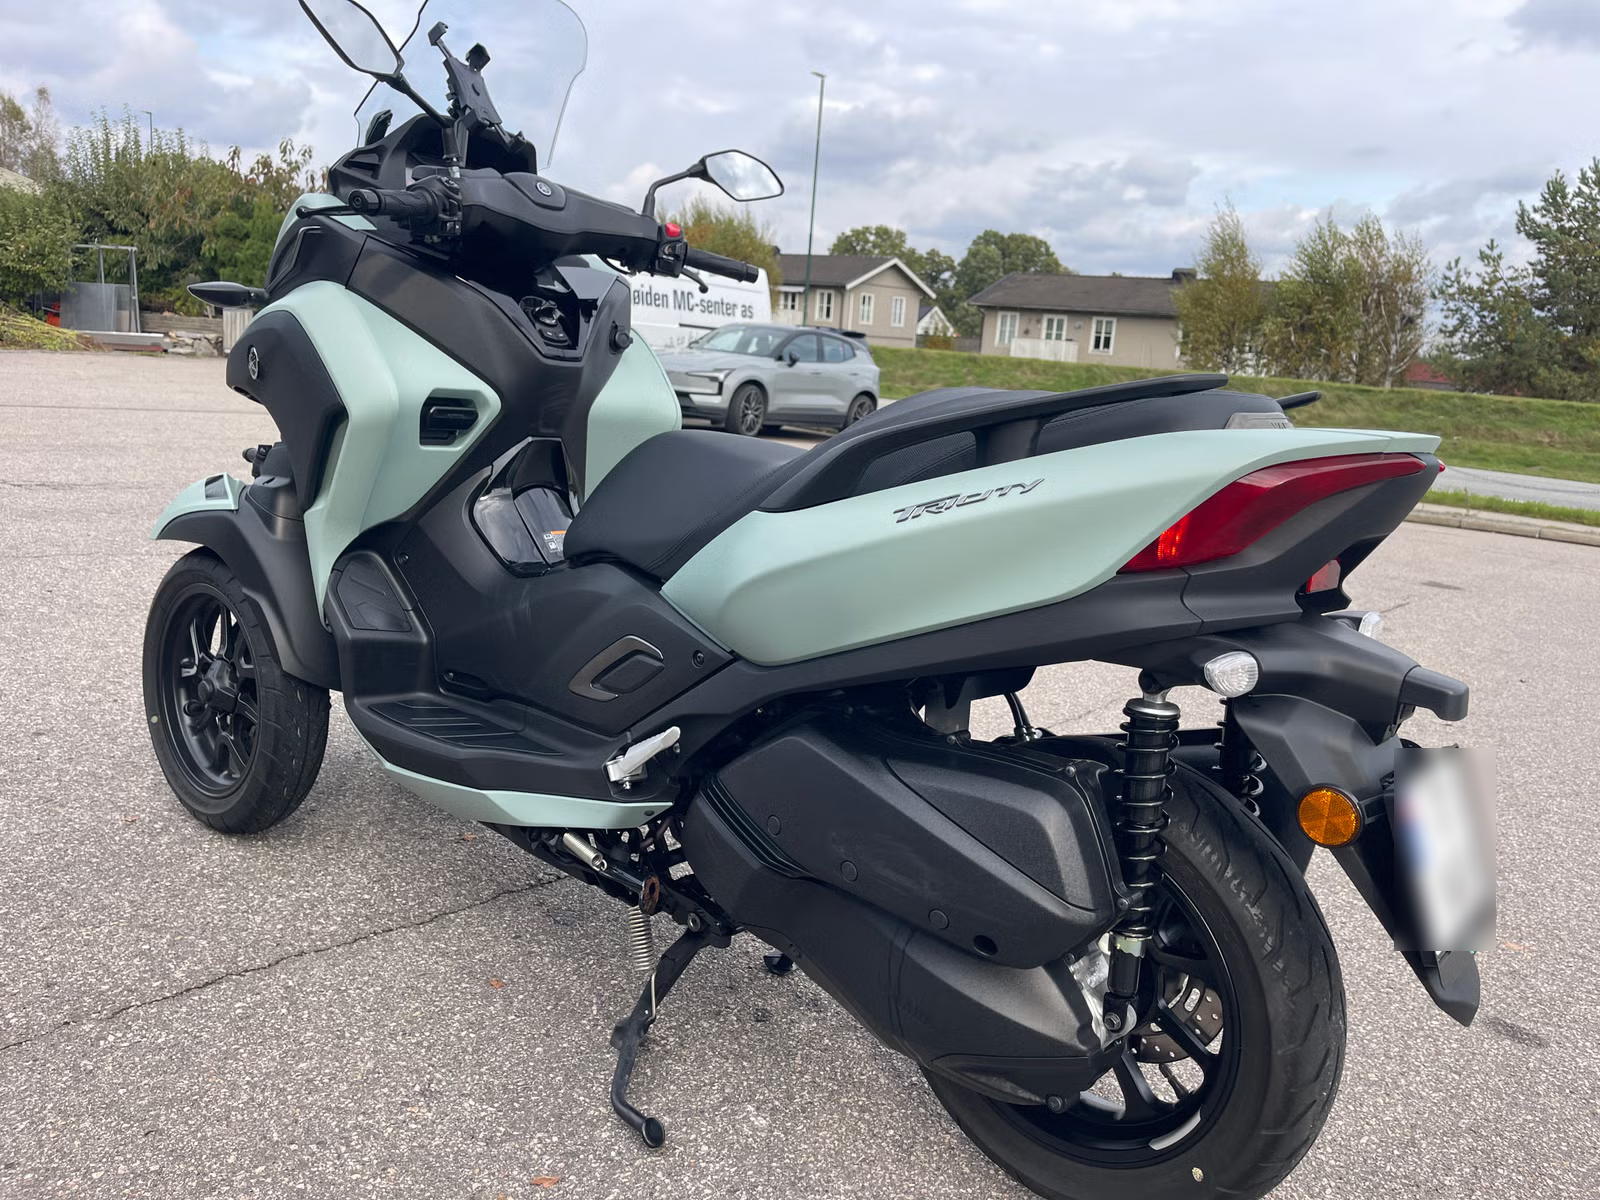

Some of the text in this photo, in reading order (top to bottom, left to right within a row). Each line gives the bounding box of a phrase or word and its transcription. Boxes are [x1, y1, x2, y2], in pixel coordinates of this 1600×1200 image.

[632, 283, 754, 319] øiden MC-senter as
[893, 478, 1045, 524] TRICITY
